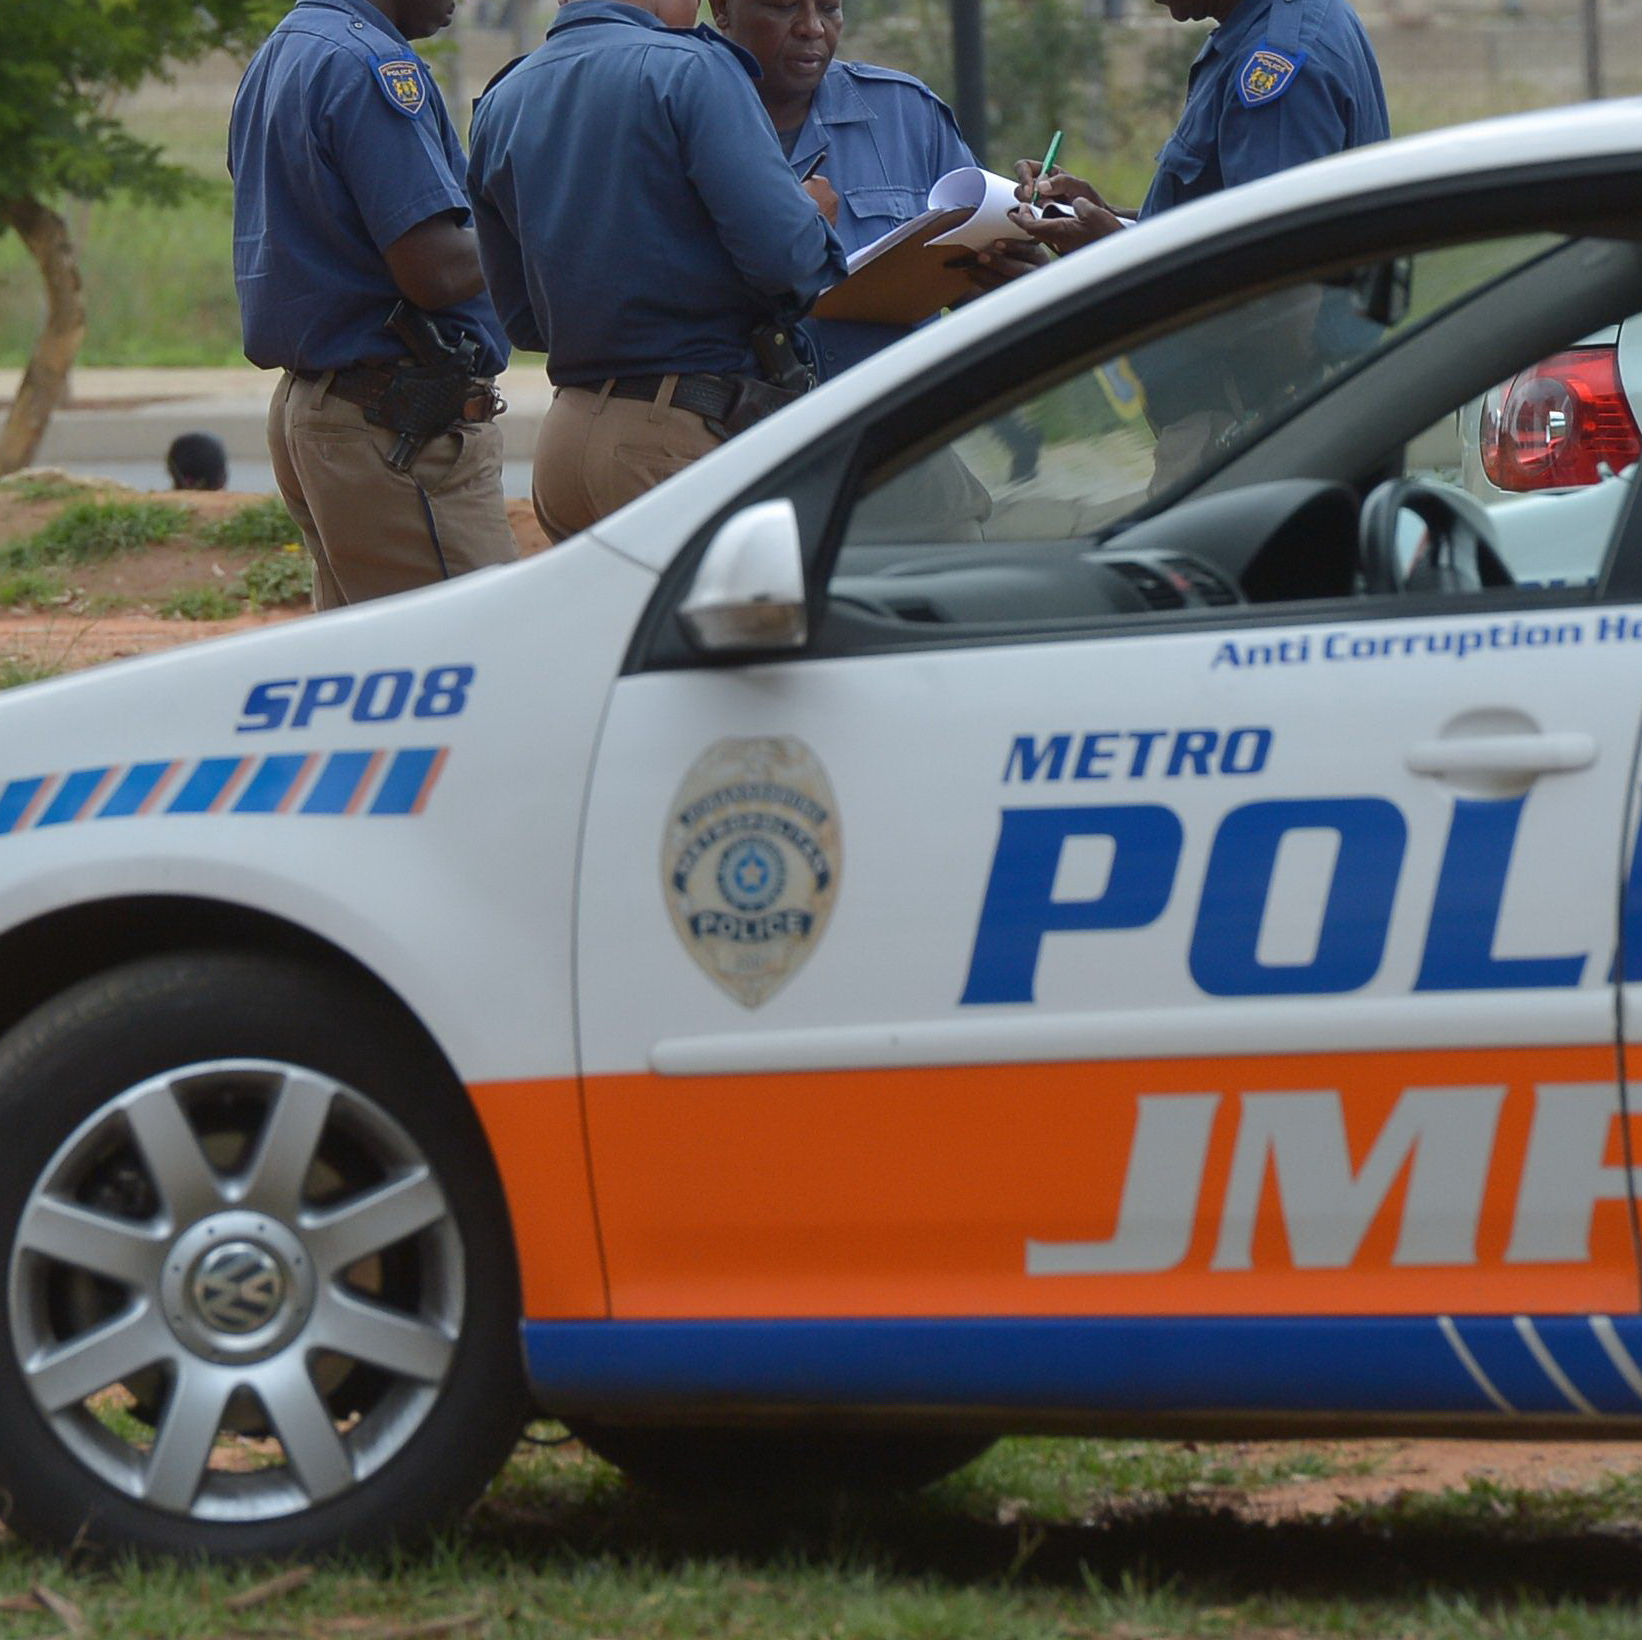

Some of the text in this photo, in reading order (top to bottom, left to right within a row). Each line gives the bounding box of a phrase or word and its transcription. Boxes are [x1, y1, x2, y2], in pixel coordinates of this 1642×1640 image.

[1212, 635, 1309, 670] Anti
[1322, 617, 1583, 660] Corruption
[236, 664, 476, 732] SP08
[1001, 727, 1273, 784] METRO
[697, 913, 811, 942] POLICE
